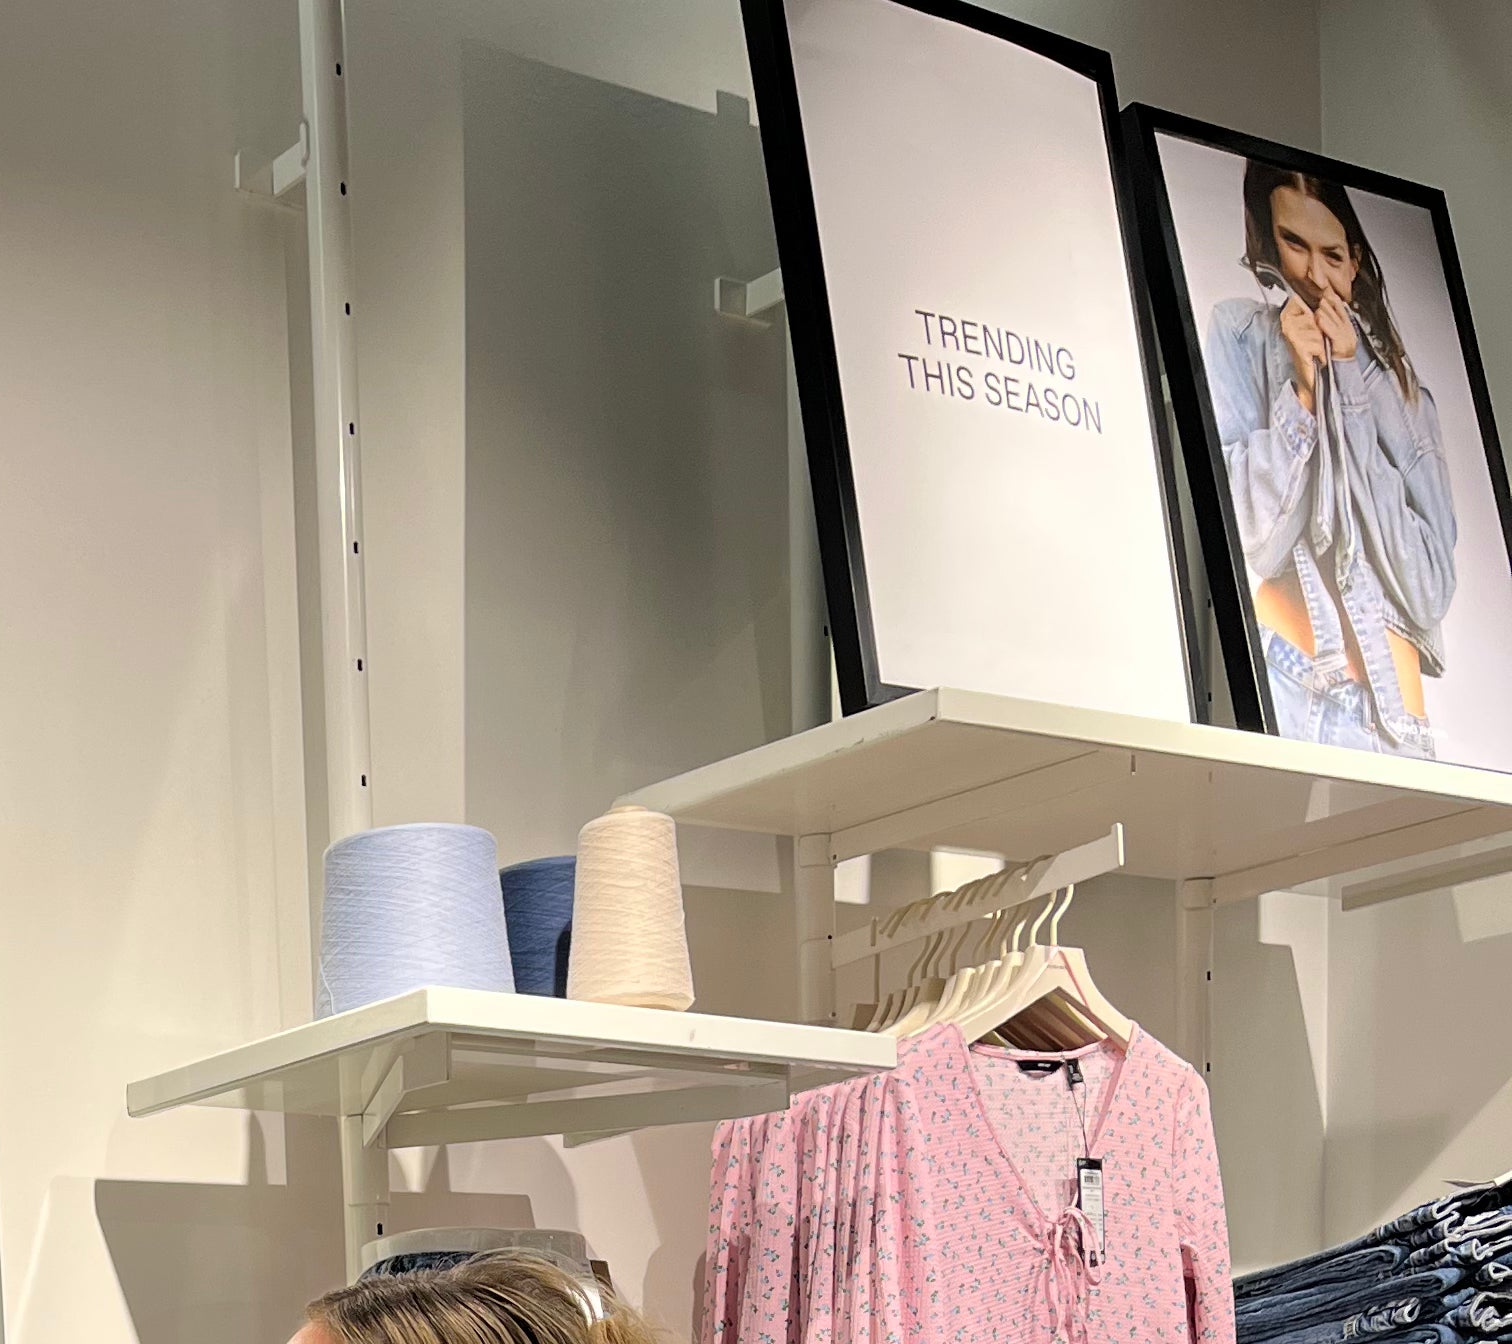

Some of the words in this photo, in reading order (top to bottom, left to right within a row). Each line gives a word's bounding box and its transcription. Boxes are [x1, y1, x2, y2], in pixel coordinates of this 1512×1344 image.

[915, 309, 1076, 380] TRENDING
[898, 353, 975, 400] THIS
[984, 372, 1102, 434] SEASON
